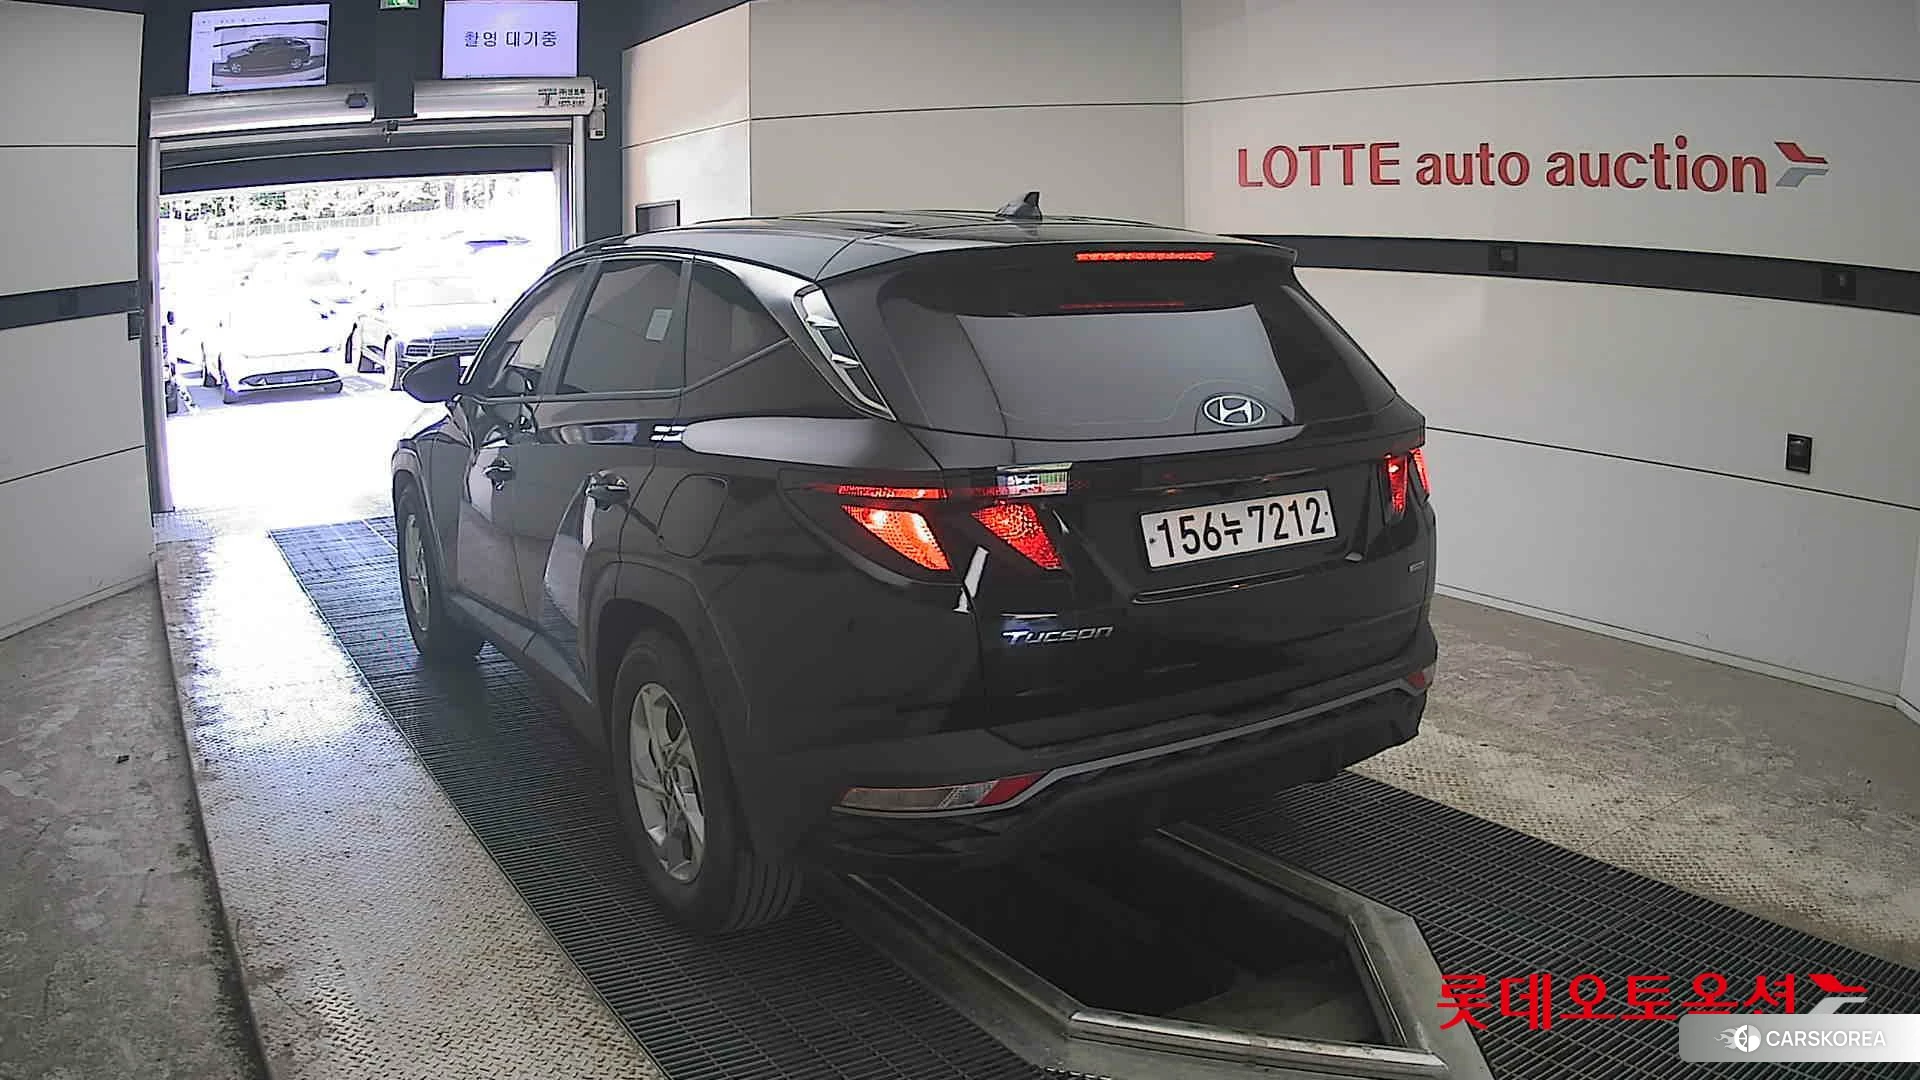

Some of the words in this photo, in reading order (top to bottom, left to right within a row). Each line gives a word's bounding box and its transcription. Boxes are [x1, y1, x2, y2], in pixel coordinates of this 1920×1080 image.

[505, 31, 558, 48] 대기중
[1237, 142, 1400, 188] LOTTE
[1416, 142, 1530, 188] auto
[1546, 135, 1767, 194] auction
